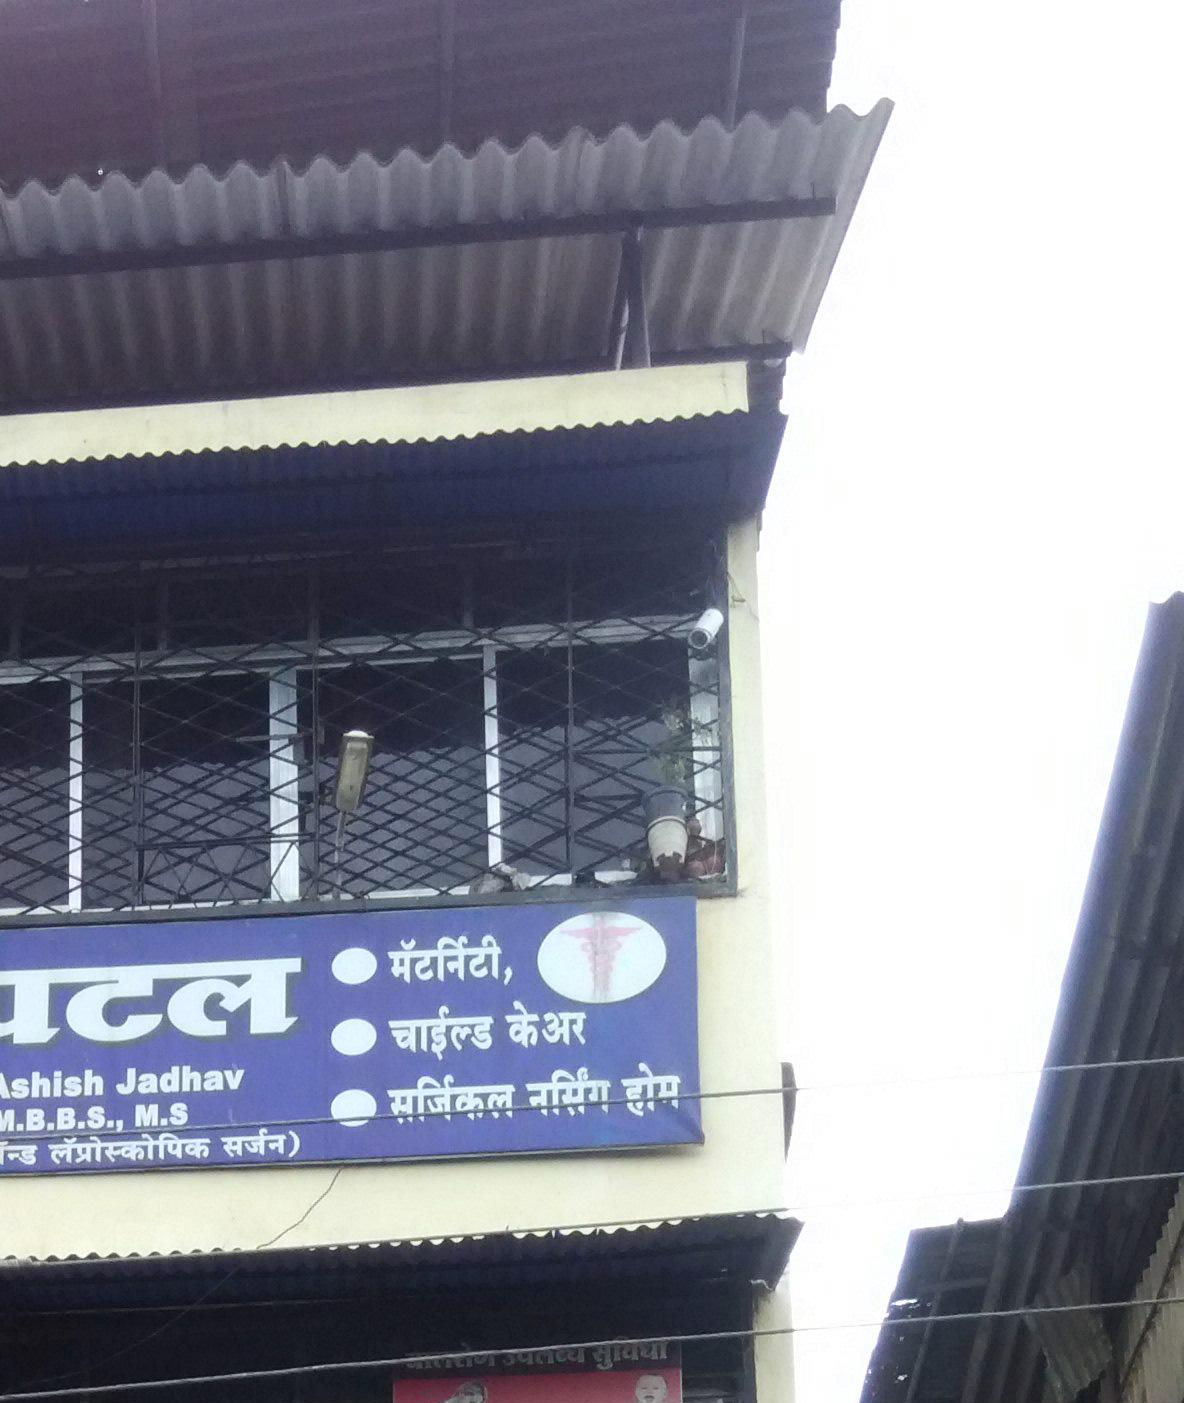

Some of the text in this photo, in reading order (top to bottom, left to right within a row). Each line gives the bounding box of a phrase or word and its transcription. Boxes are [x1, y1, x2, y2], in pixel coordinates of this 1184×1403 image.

[389, 1005, 495, 1060] चाईल्ड
[116, 1065, 244, 1095] Jadhav
[621, 1063, 681, 1117] होम
[135, 1103, 189, 1127] M.S
[223, 1129, 301, 1159] सर्जन)
